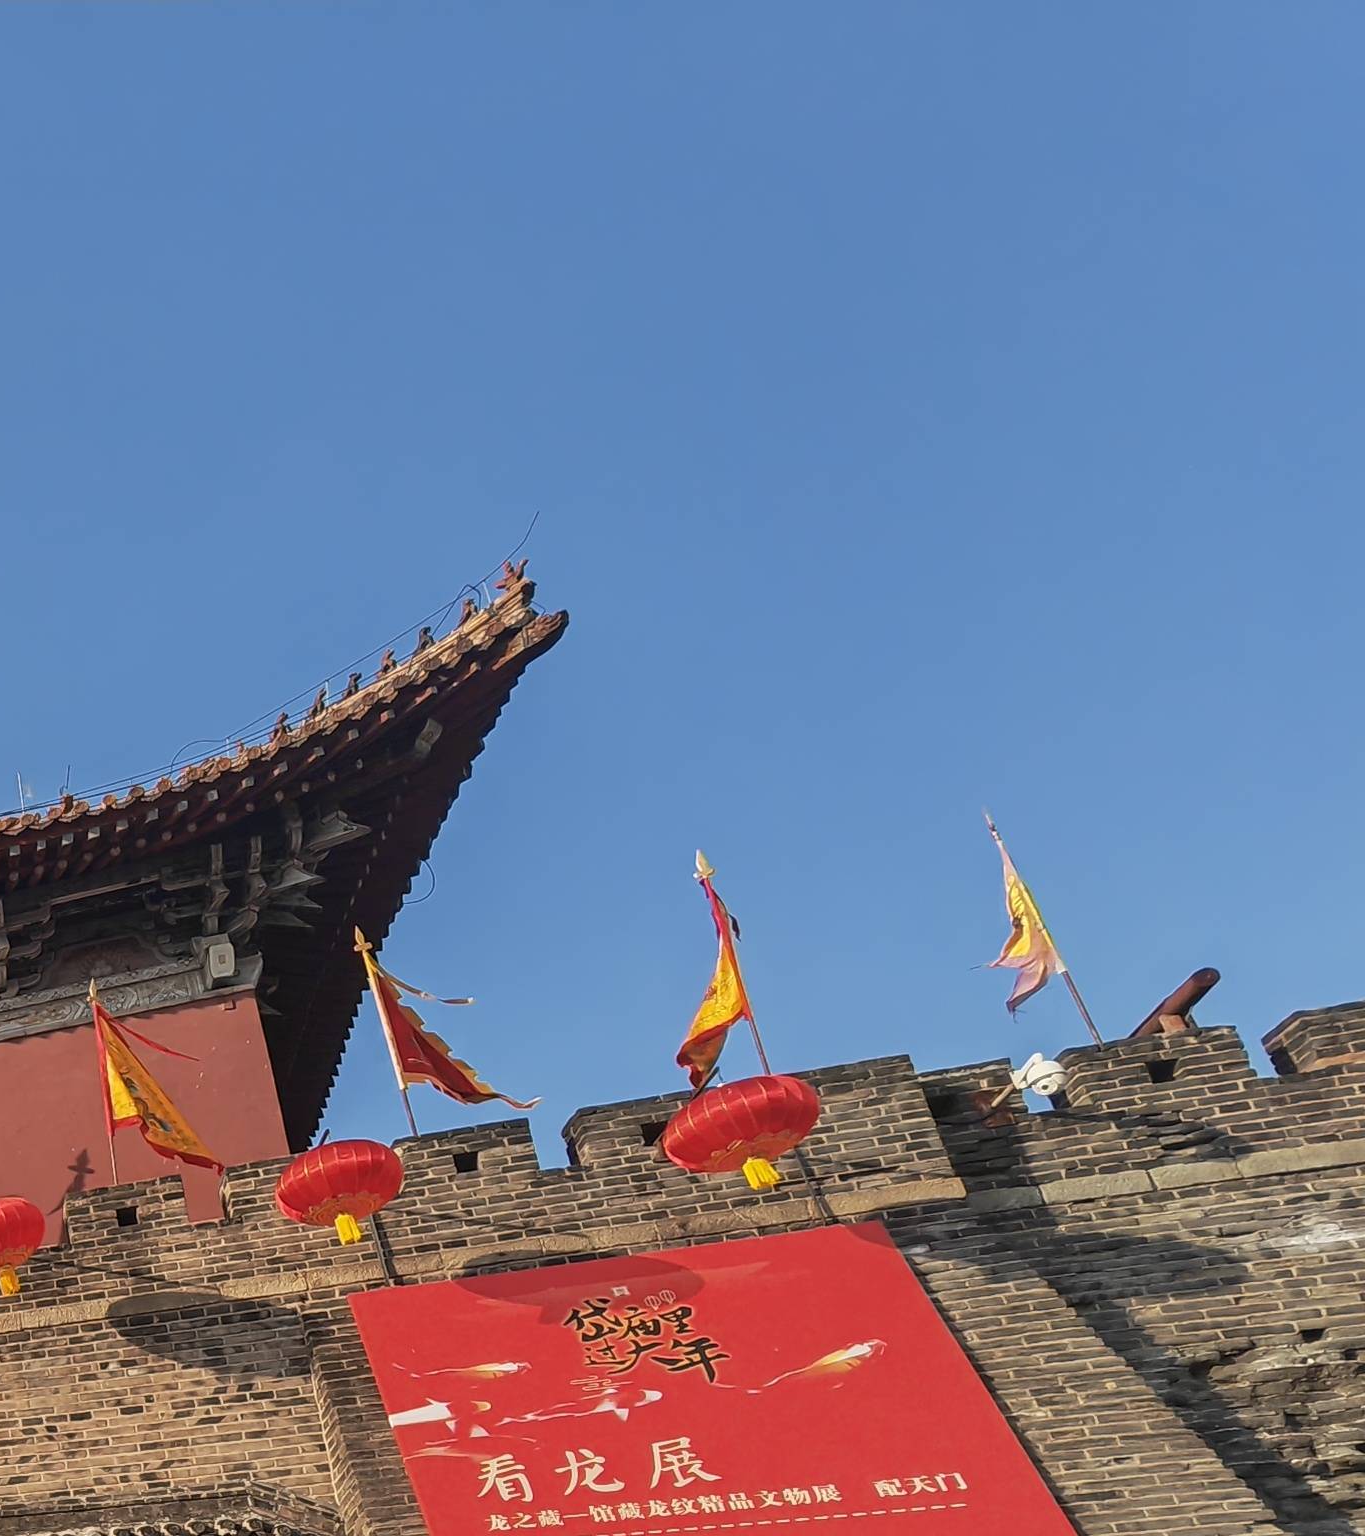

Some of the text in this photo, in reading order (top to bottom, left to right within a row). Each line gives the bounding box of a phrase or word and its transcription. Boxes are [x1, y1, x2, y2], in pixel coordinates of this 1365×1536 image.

[477, 1436, 721, 1503] 看龙展
[872, 1472, 968, 1499] 配天门
